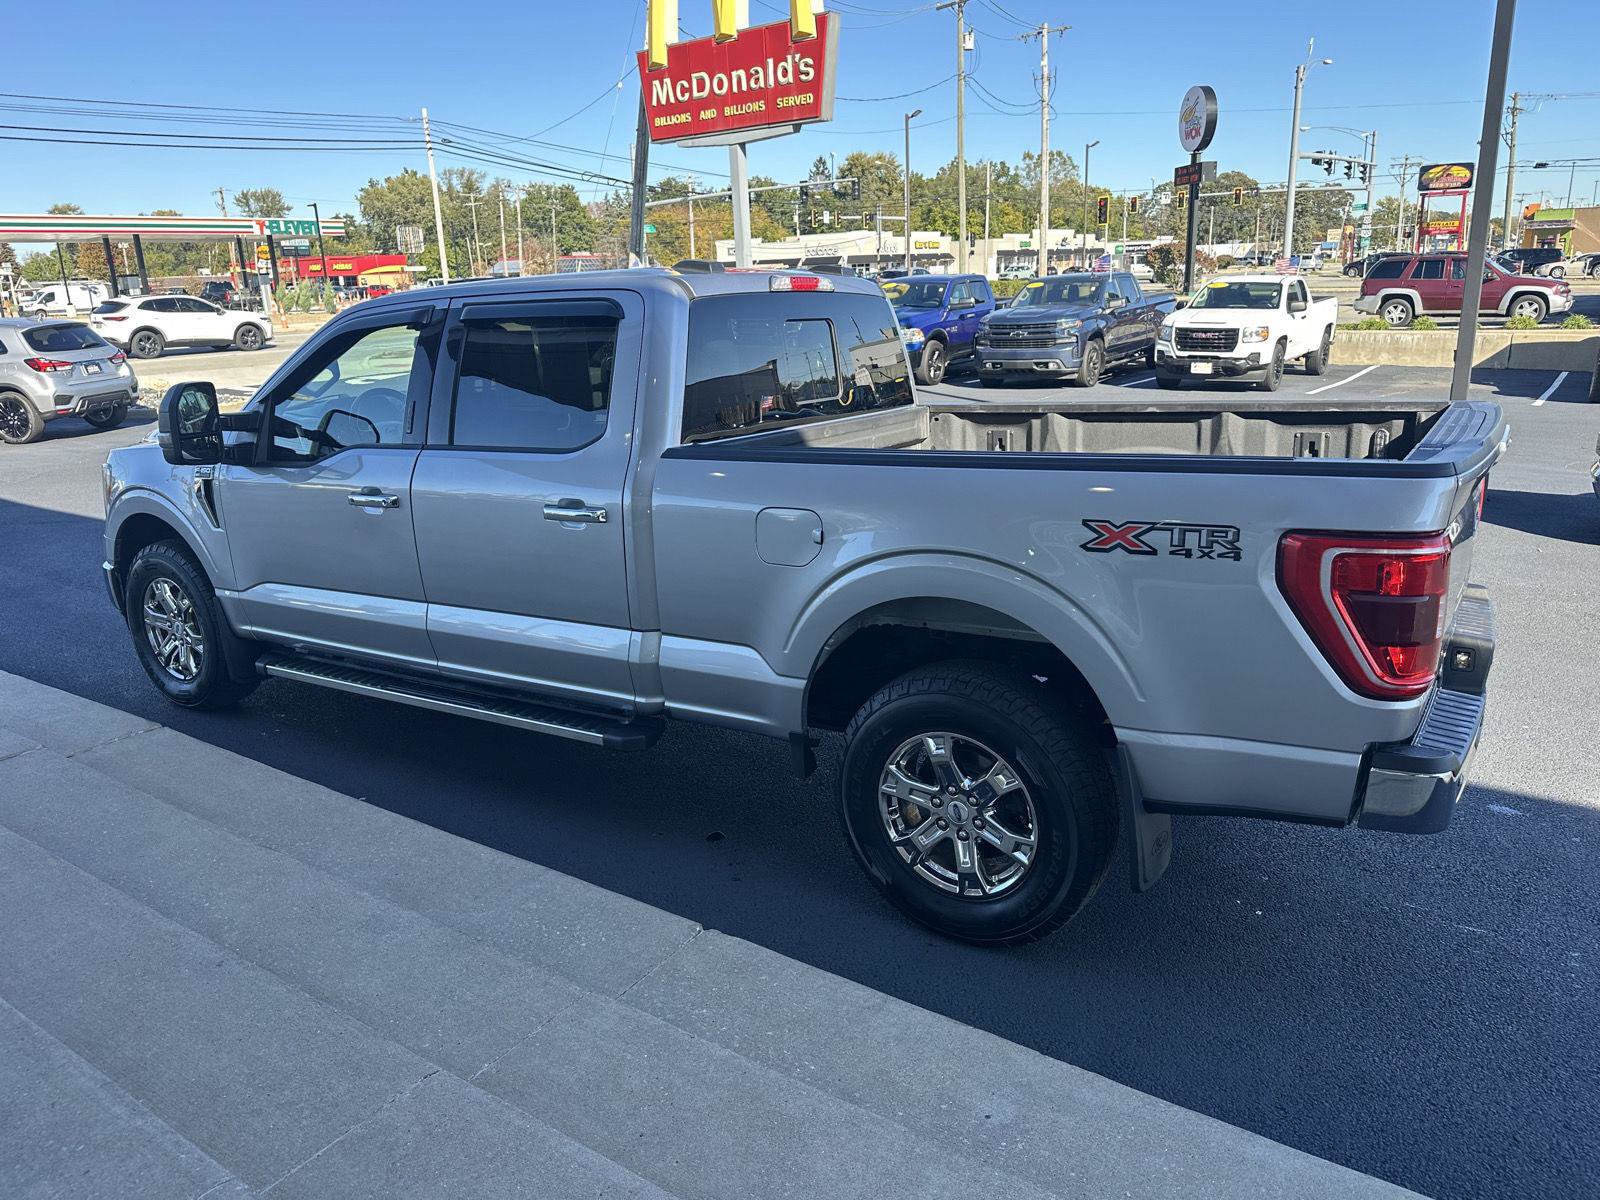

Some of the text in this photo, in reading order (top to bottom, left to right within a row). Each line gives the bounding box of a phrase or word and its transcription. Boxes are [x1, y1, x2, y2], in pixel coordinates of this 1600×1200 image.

[651, 53, 815, 107] McDonald's
[654, 92, 814, 127] BILLIONS AND BILLIONS SERVED
[1079, 519, 1243, 556] XTR
